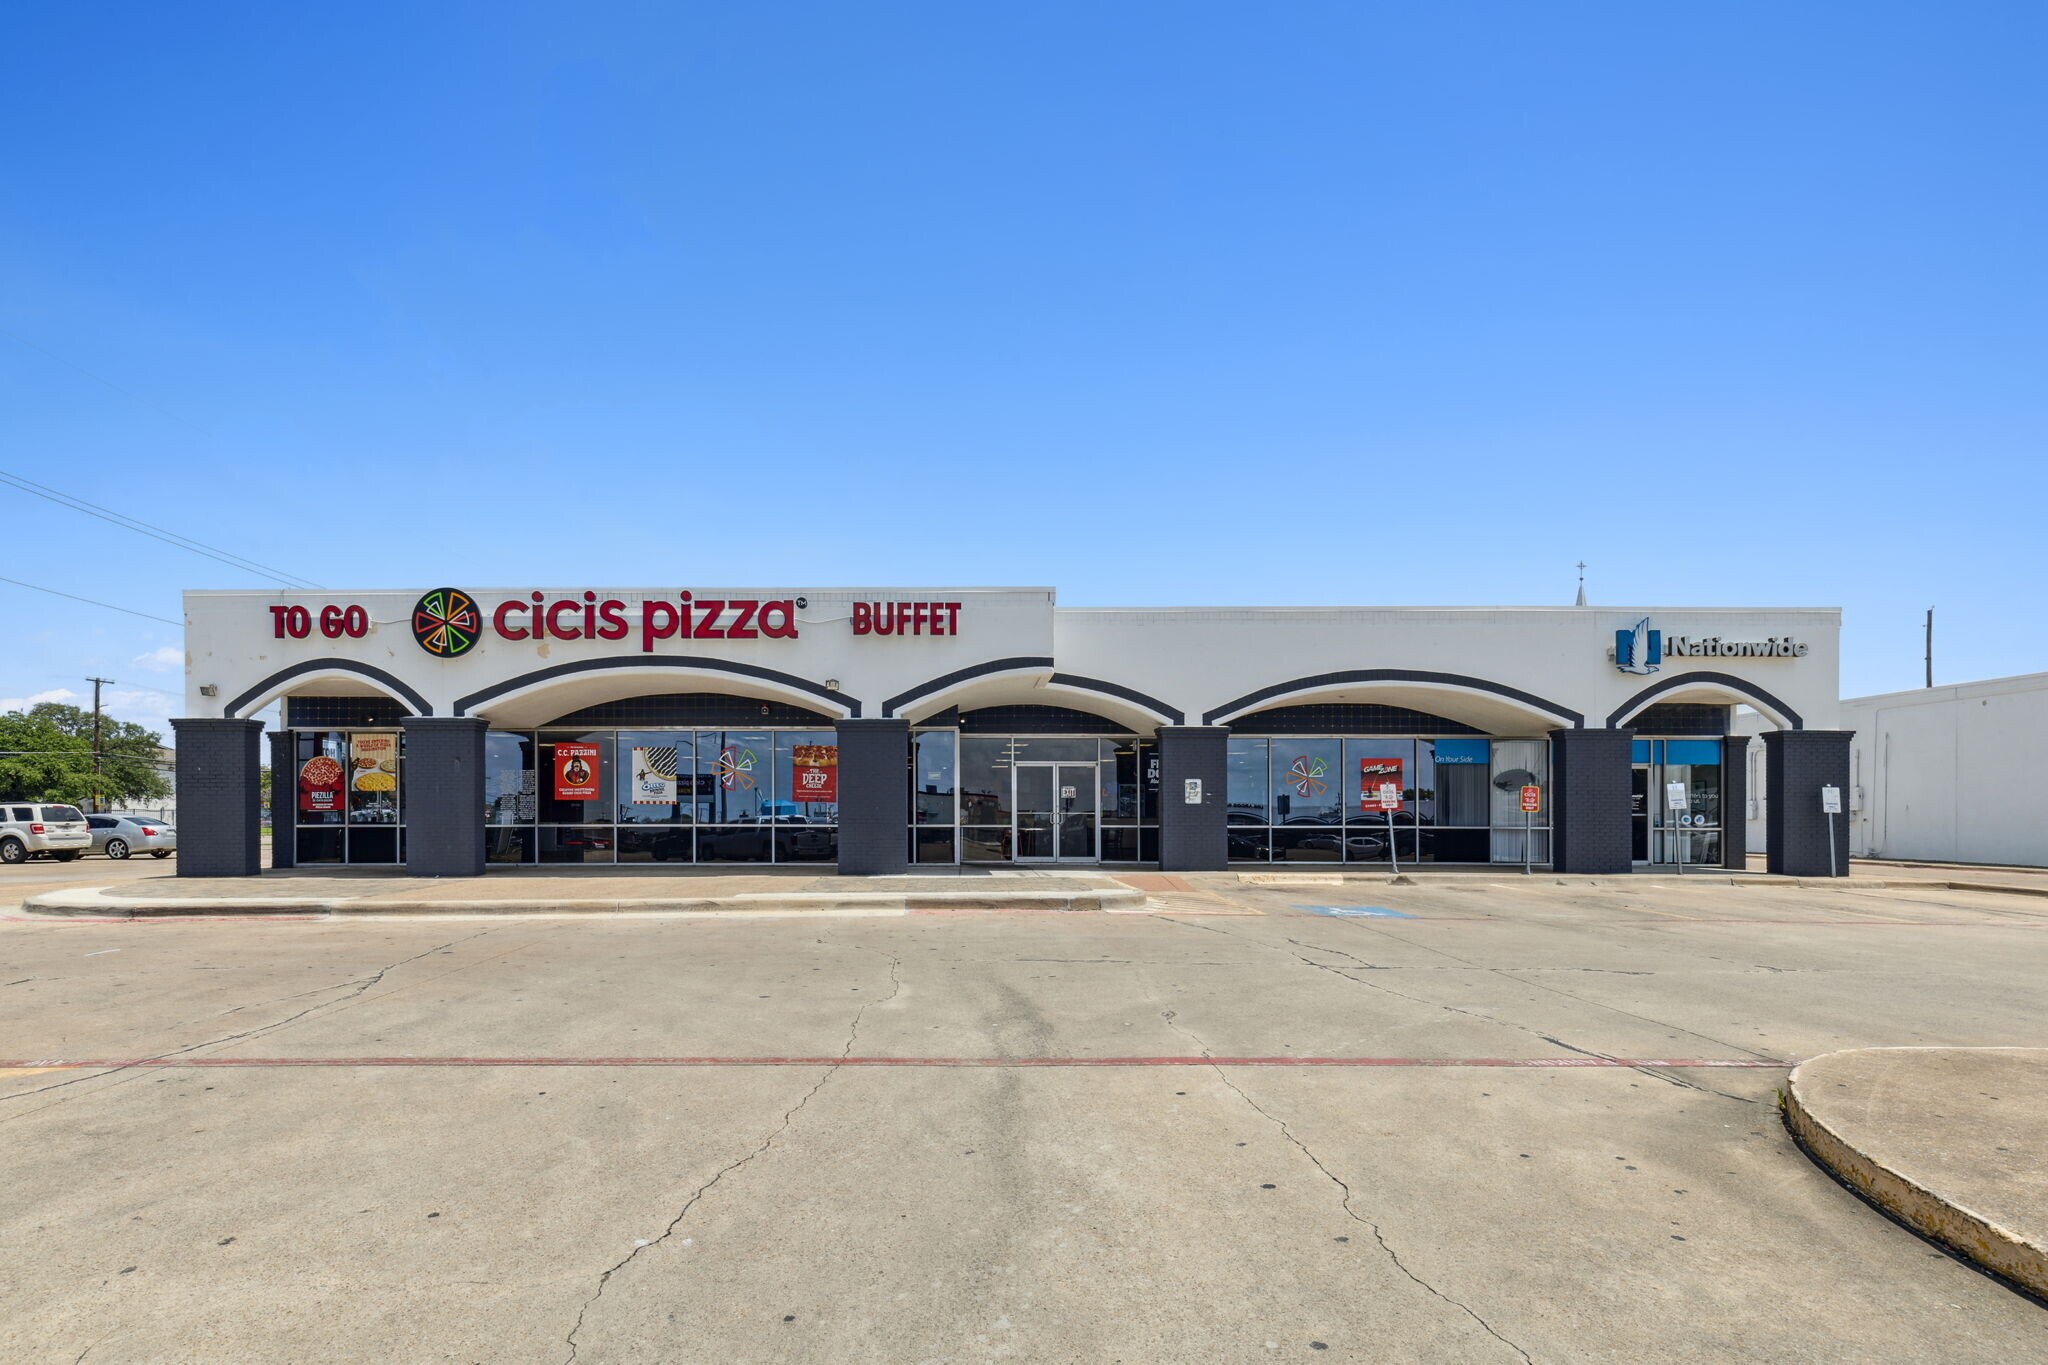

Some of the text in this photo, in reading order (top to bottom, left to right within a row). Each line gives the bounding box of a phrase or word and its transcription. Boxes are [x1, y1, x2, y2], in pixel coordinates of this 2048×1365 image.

[269, 604, 370, 639] TO GO
[493, 590, 799, 653] cicis pizza
[852, 602, 962, 636] BUFFET
[1668, 636, 1809, 657] Nationwide
[571, 749, 597, 757] PAZZINI
[1364, 764, 1398, 774] GAME ZONE
[802, 774, 827, 785] DEEP
[311, 791, 333, 799] PIEZILLA
